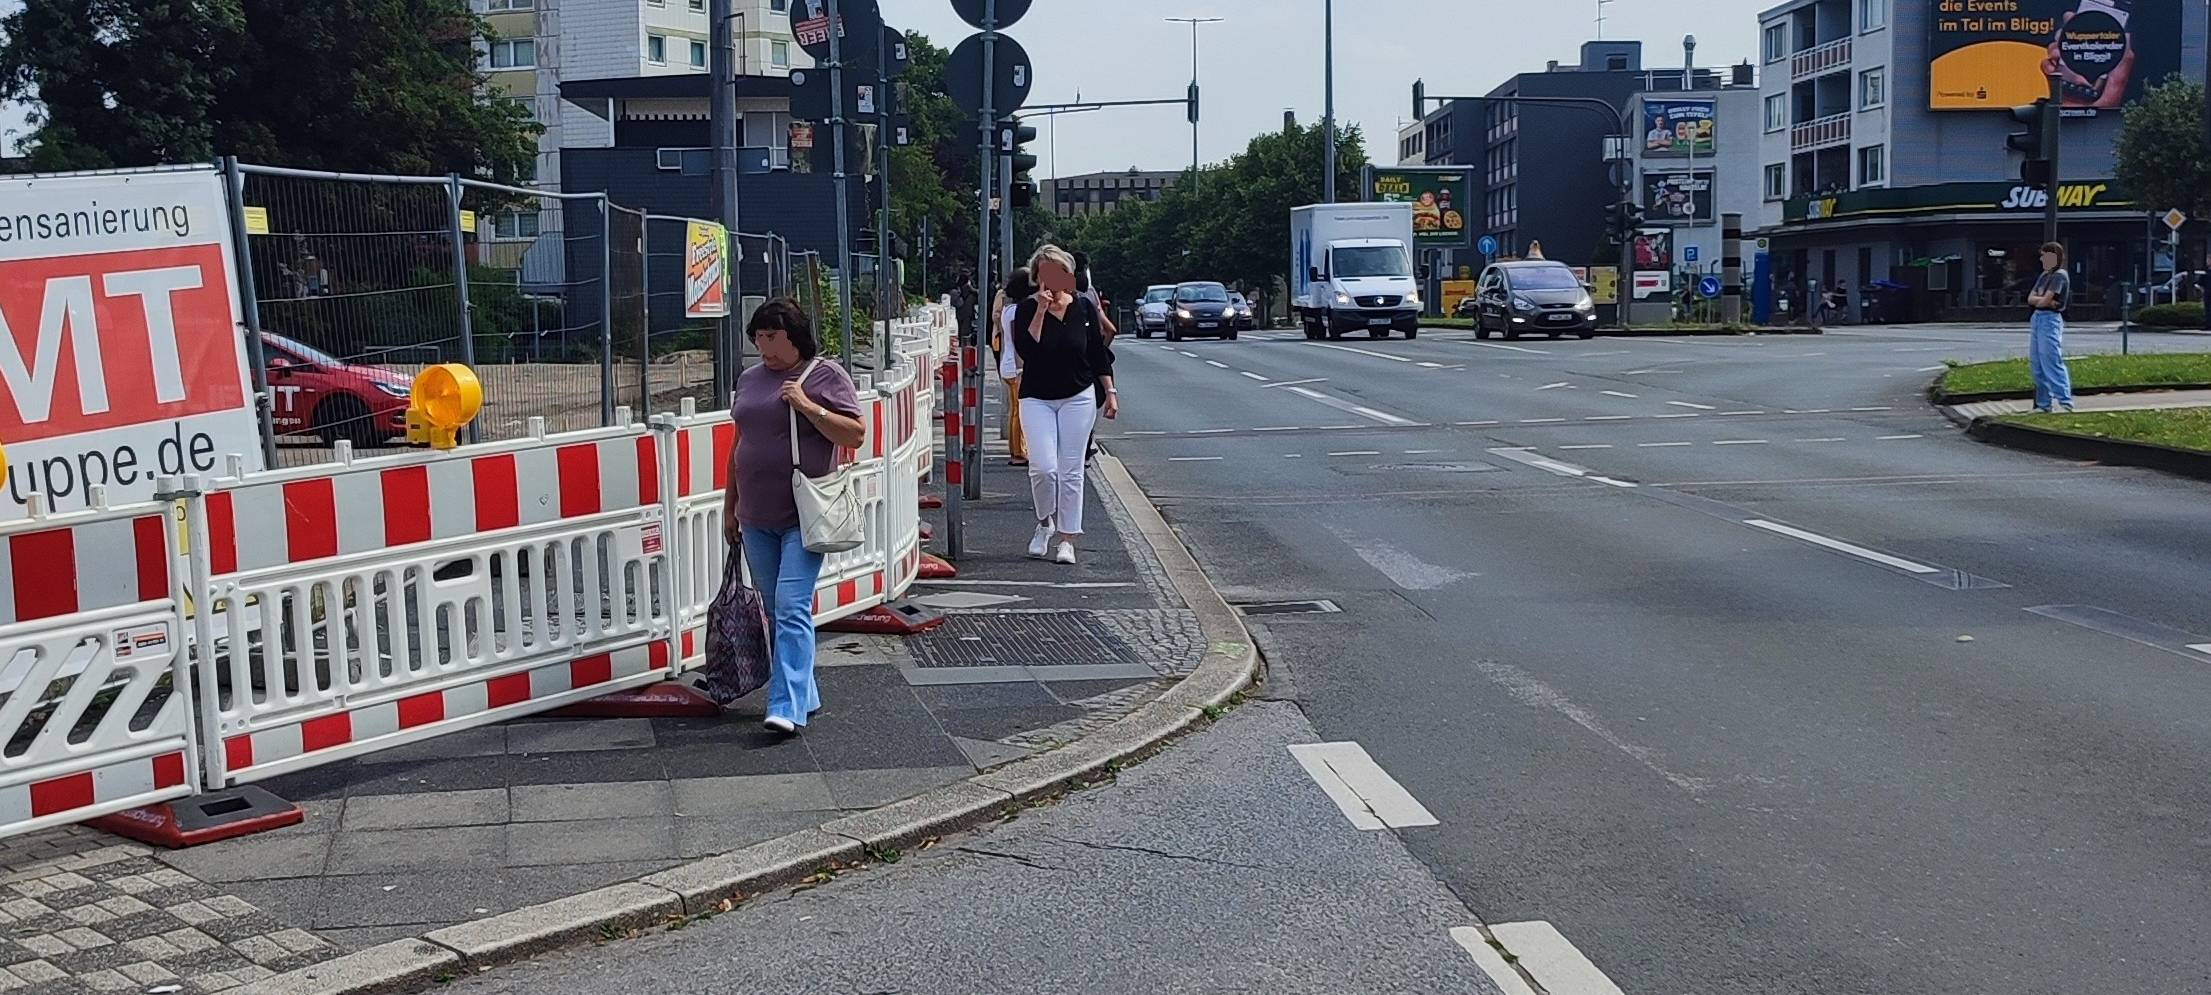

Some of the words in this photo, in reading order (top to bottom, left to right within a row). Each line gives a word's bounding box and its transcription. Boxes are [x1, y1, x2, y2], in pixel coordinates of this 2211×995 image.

[1939, 0, 1963, 11] die
[1967, 0, 2017, 12] Events
[1939, 18, 1957, 31] im
[1960, 18, 1984, 31] Tal
[1987, 18, 2006, 31] im
[2010, 17, 2055, 34] Bligg!
